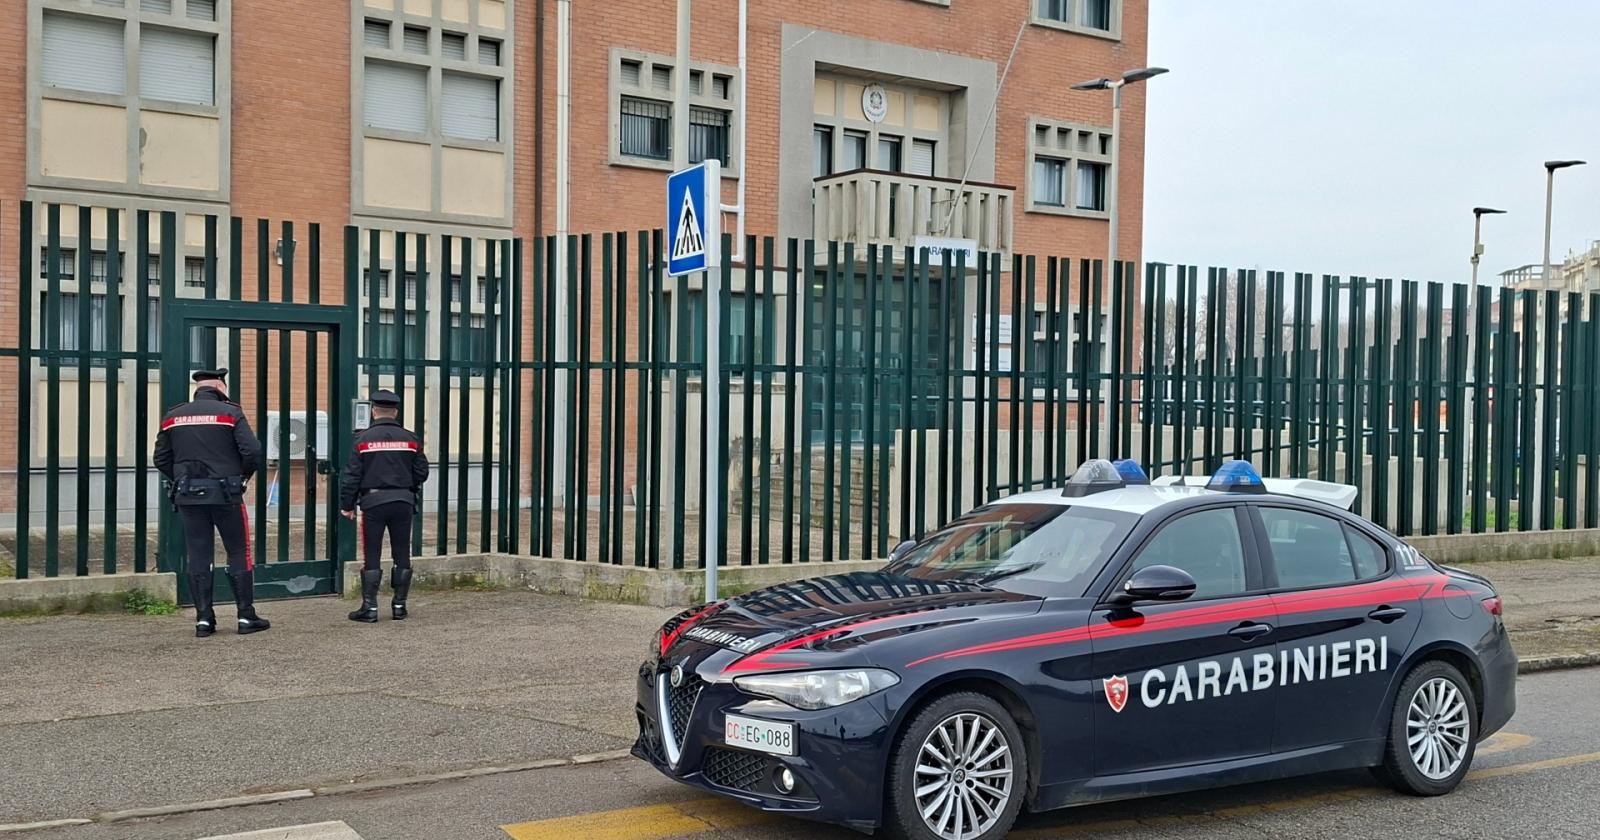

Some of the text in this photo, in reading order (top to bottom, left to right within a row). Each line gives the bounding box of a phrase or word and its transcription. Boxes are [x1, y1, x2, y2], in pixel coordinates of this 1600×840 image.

[174, 415, 217, 424] CARABINIERI
[367, 441, 409, 449] CARABINIERI
[1396, 544, 1426, 566] 112
[685, 626, 761, 651] CARABINIERI
[1140, 636, 1388, 708] CARABINIERI
[766, 729, 790, 748] 088
